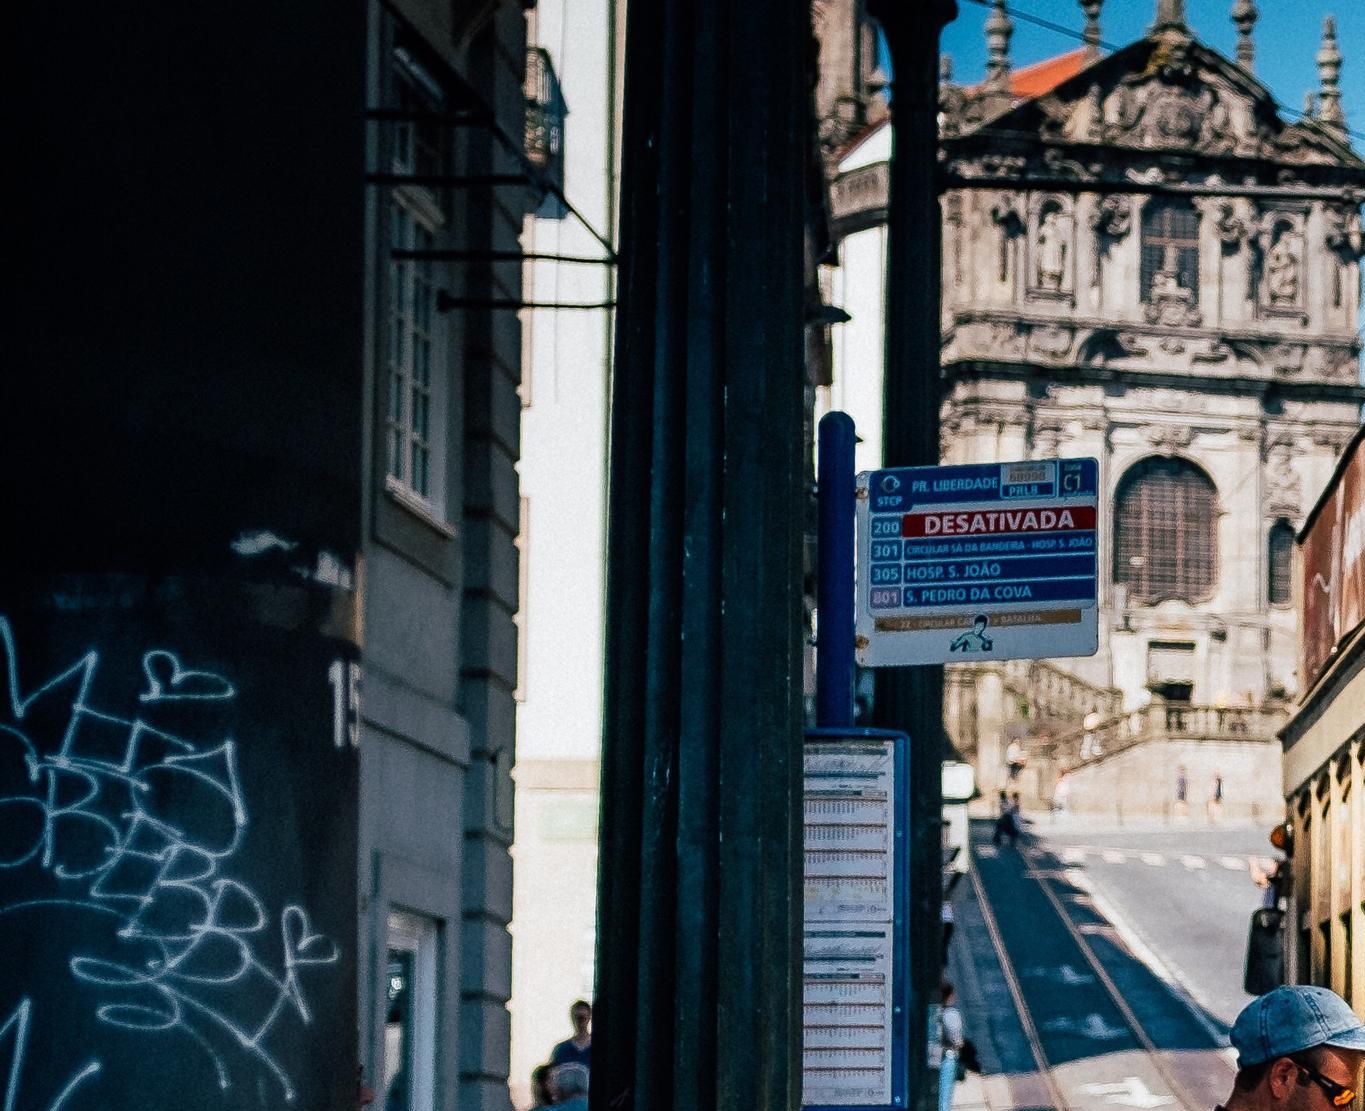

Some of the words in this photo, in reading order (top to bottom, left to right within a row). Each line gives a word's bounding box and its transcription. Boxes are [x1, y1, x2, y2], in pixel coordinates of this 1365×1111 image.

[911, 480, 930, 493] PR.
[933, 477, 999, 492] LIBERDADE
[1063, 473, 1081, 490] C1
[877, 496, 903, 507] STCP
[873, 521, 900, 534] 200
[924, 510, 1075, 534] DESATIVADA
[873, 544, 898, 558] 301
[906, 543, 949, 555] CIRCULAR
[964, 542, 979, 552] DA
[979, 540, 1025, 552] BANDEIRA
[1068, 535, 1093, 548] JOÃO
[873, 567, 899, 581] 305
[906, 565, 945, 580] HOSP.
[948, 564, 960, 578] S.
[963, 561, 1002, 578] JOÃO
[873, 590, 898, 604] 801
[906, 589, 918, 603] S.
[921, 588, 966, 602] PEDRO
[969, 587, 991, 600] DA
[994, 585, 1032, 599] COVA
